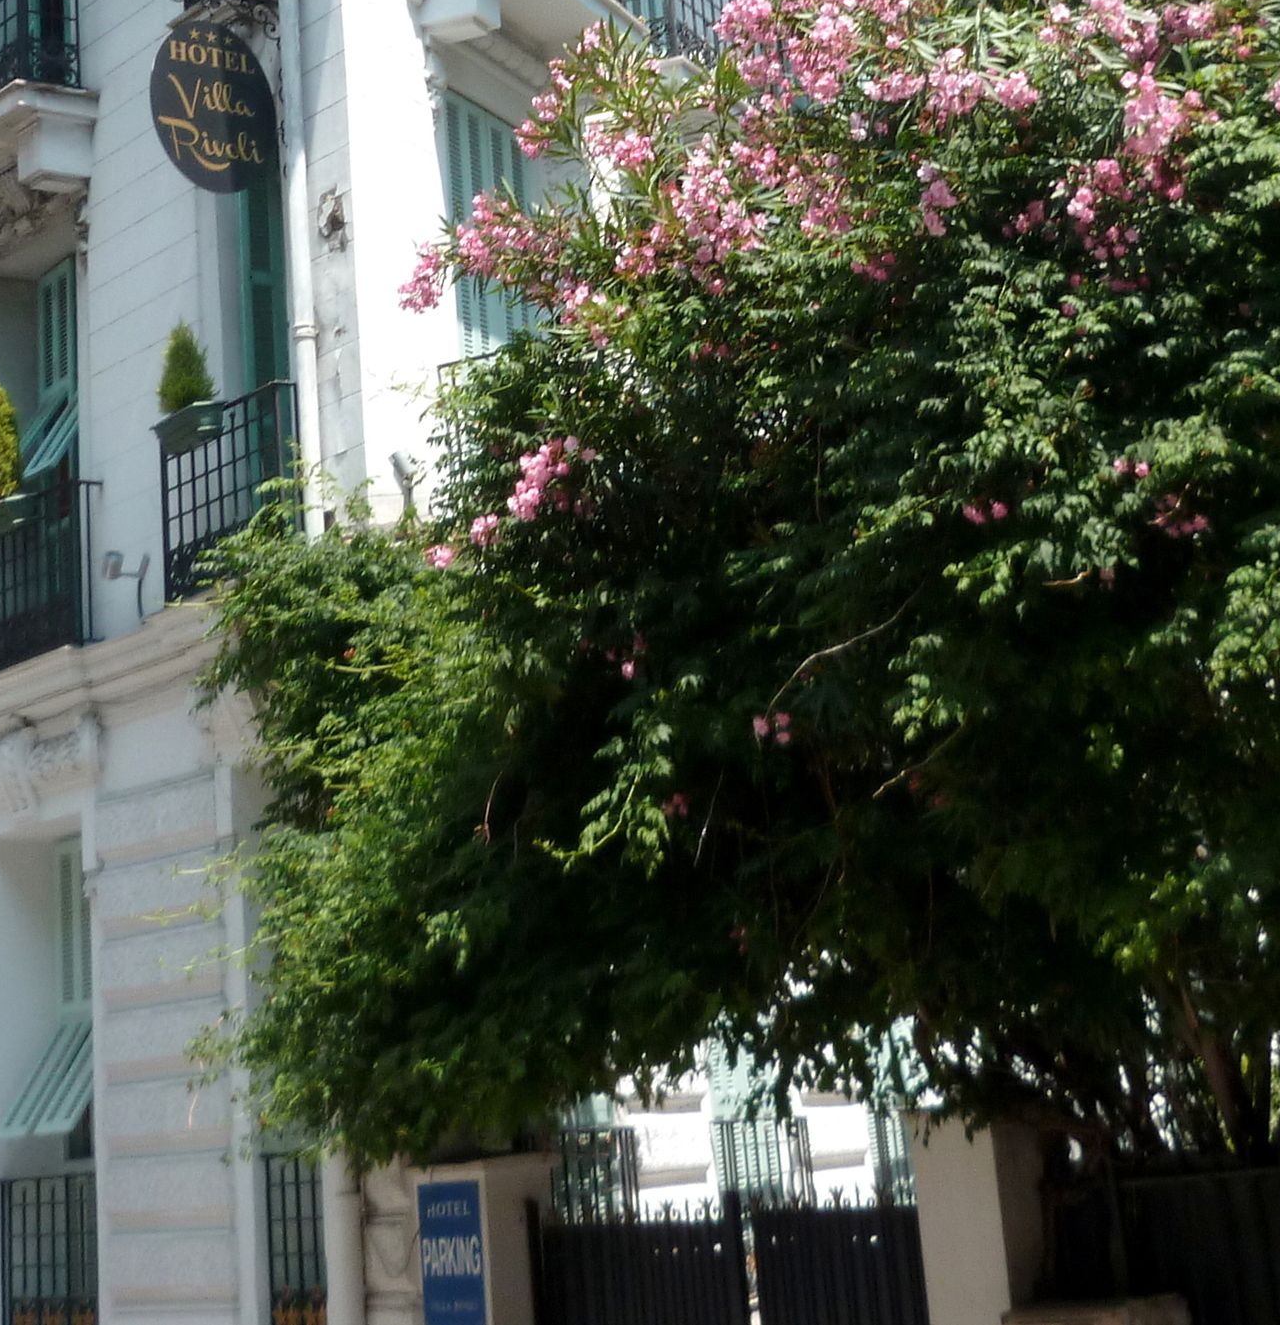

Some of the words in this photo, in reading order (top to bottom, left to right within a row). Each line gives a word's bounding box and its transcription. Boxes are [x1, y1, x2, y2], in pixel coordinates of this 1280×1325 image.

[169, 40, 256, 74] HOTEL
[167, 73, 256, 119] Villa
[158, 116, 265, 172] Rivoli
[426, 1199, 472, 1218] HOTEL
[422, 1235, 481, 1277] PARKING
